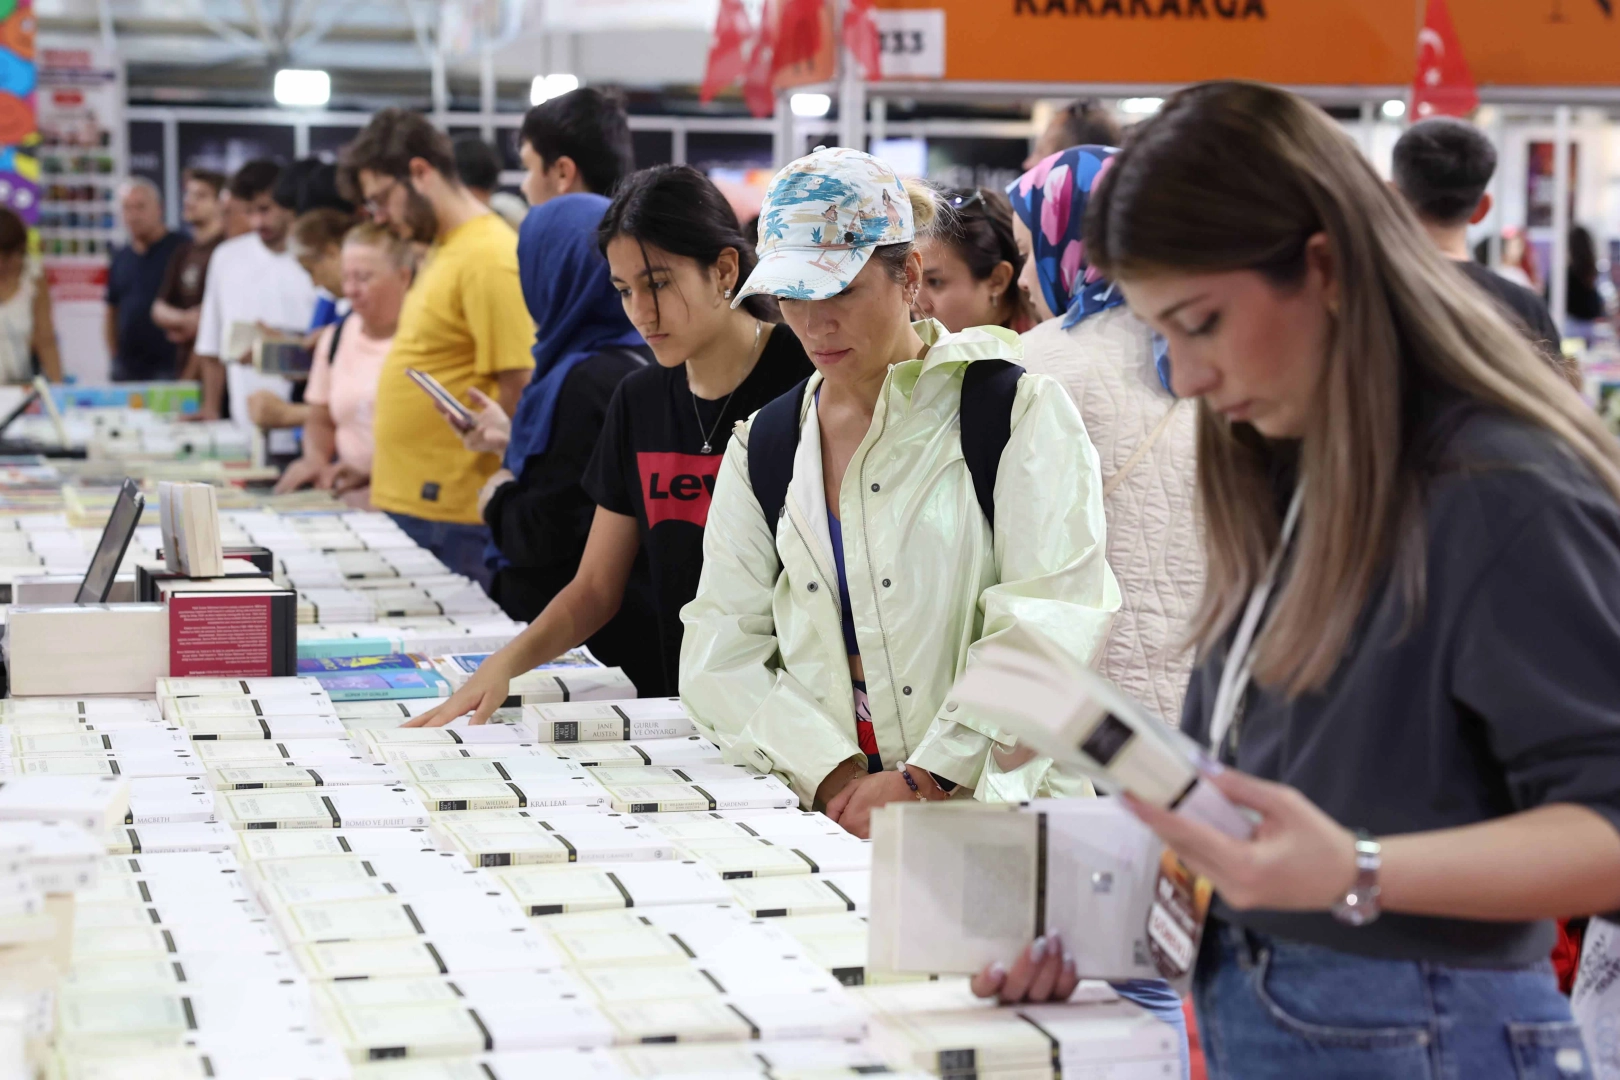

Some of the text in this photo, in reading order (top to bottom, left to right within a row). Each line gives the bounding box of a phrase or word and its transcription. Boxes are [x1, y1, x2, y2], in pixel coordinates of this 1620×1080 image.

[644, 727, 677, 736] ÖNYARGI
[137, 816, 170, 824] MACBETH
[383, 818, 405, 826] JULIET
